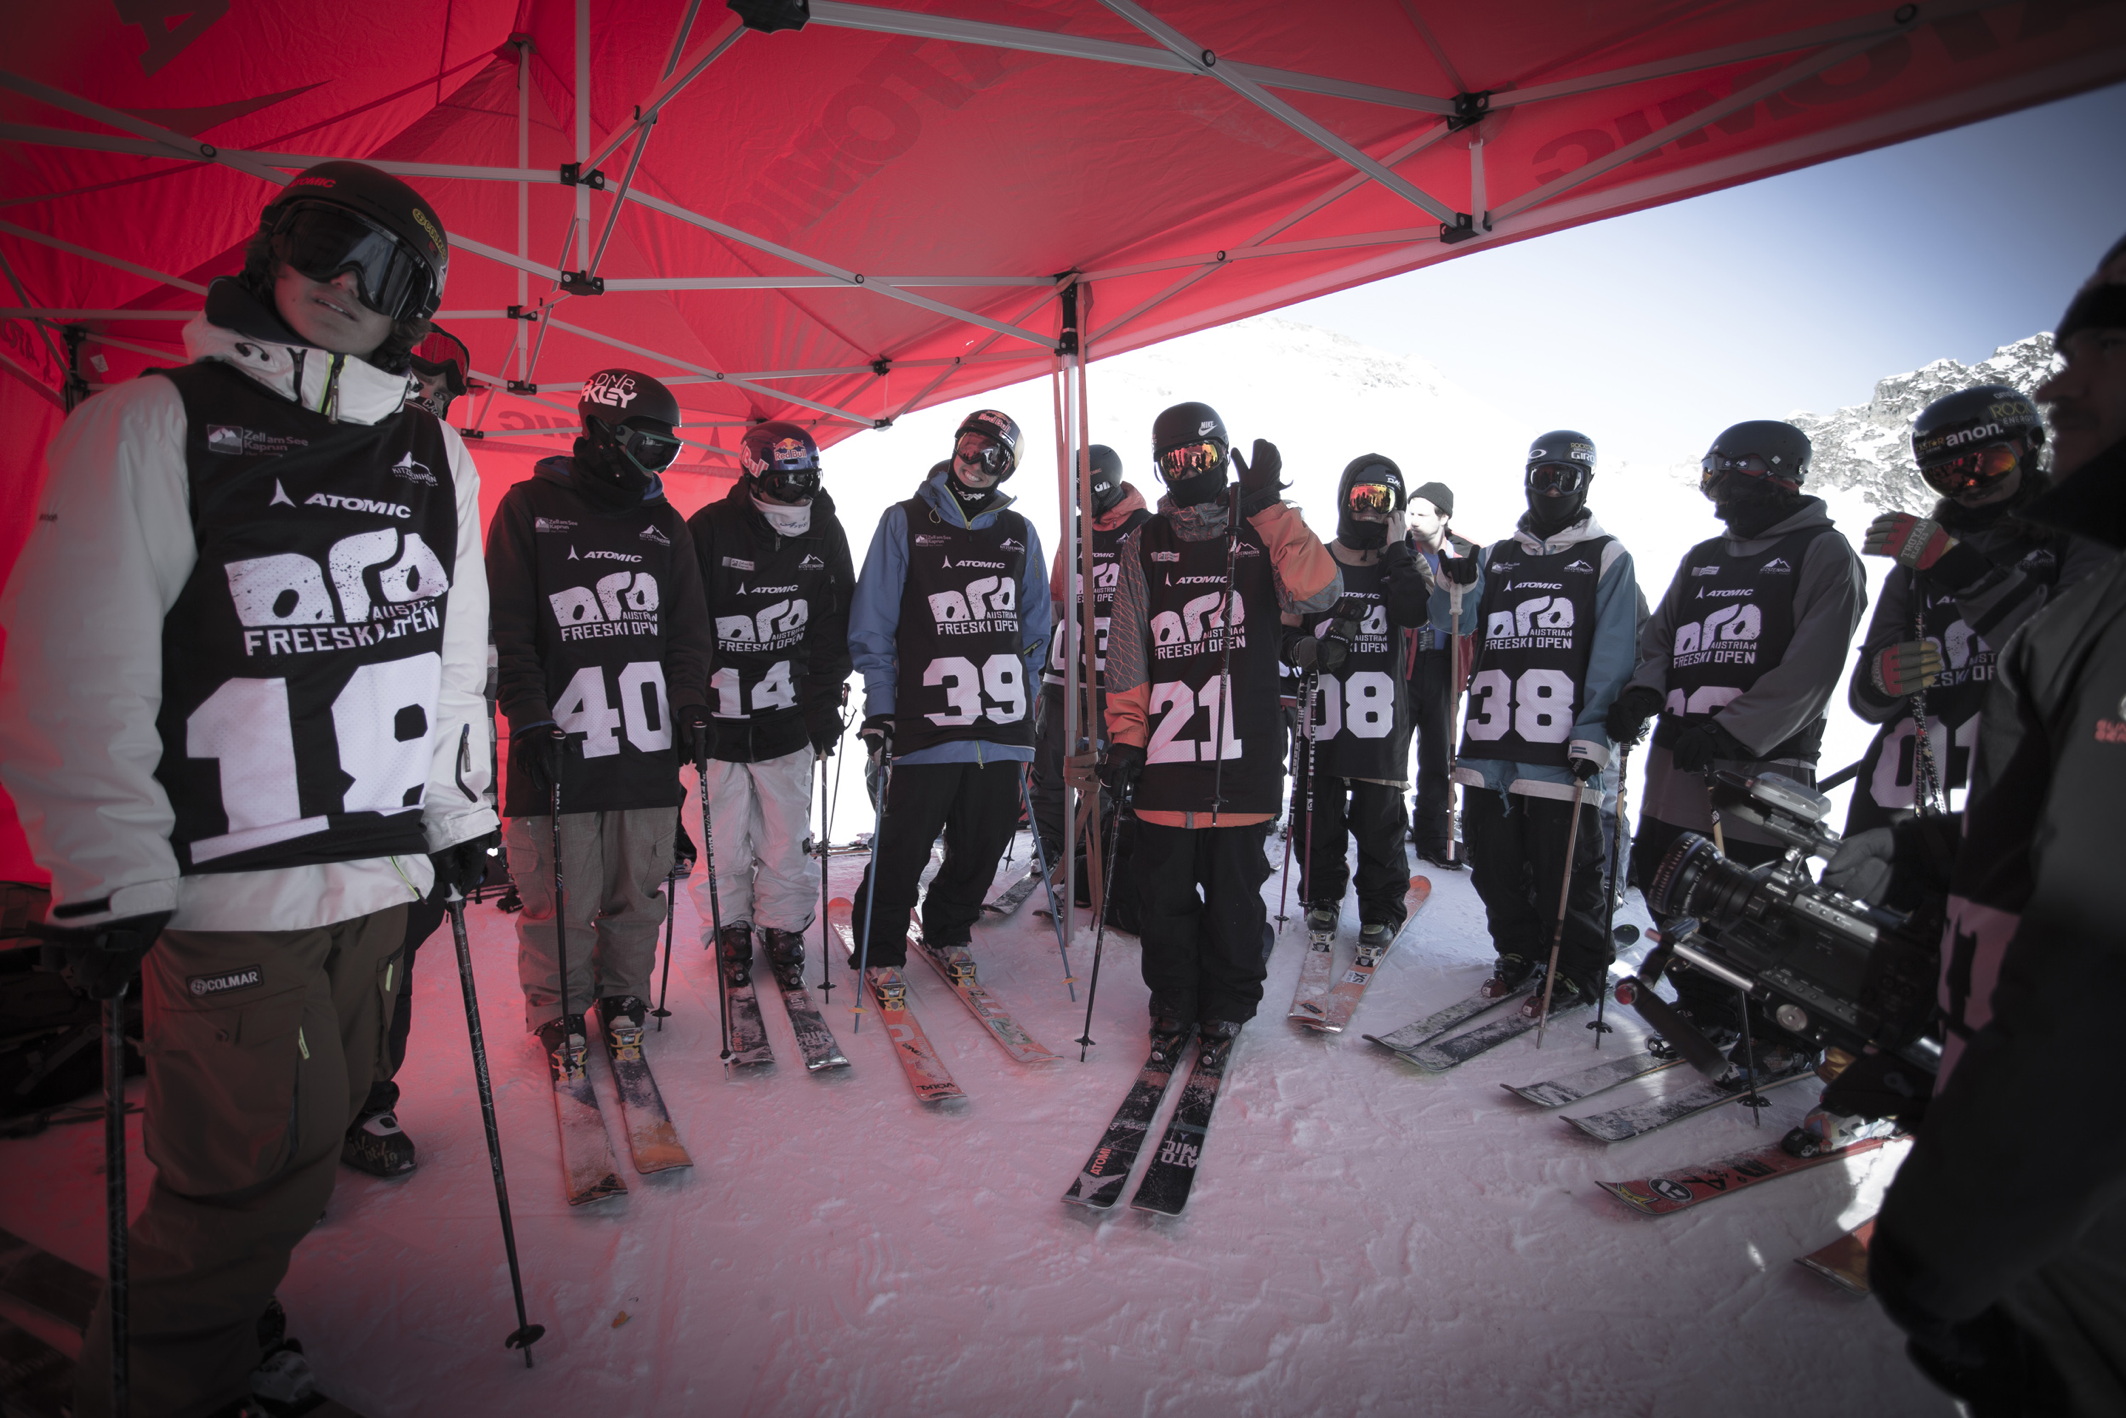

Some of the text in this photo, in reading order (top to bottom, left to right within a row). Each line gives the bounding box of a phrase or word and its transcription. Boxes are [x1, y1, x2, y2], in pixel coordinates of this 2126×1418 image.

[1201, 420, 1214, 429] NIKE
[244, 429, 309, 447] Zell am See
[1945, 423, 2004, 447] anon.
[244, 440, 288, 453] Kaprun
[774, 448, 808, 461] Red Bull
[1571, 452, 1595, 462] GIRO
[304, 493, 412, 519] ATOMIC
[1900, 519, 1929, 557] TROYAN
[583, 549, 643, 563] ATOMIC
[955, 560, 1006, 569] ATOMIC
[1176, 575, 1227, 584] ATOMIC
[1514, 581, 1563, 590] ATOMIC
[751, 584, 799, 594] ATOMIC
[1706, 588, 1754, 597] ATOMIC
[1097, 593, 1114, 602] OPE
[622, 611, 658, 622] AUSTRN
[986, 611, 1018, 620] AUSTRIAN
[561, 621, 658, 642] FREESKI OPN
[771, 626, 806, 641] AUSTRIAN
[937, 619, 1019, 635] FREESKI OPEN
[1203, 626, 1245, 639] AUSTIAN
[1529, 628, 1573, 637] AUSTRIAN
[718, 633, 804, 652] FREESKI OPEN
[1354, 634, 1388, 642] AUSTRAN
[1484, 636, 1572, 651] FREESKI OPEN
[1361, 642, 1388, 653] OPEN
[1710, 641, 1757, 651] AUSTRIAN
[1673, 650, 1756, 669] FREESKI OPEN
[710, 660, 798, 719] 14
[923, 653, 1027, 727] 39
[551, 661, 672, 759] 40
[1303, 671, 1395, 742] 08
[1466, 669, 1574, 744] 38
[1145, 674, 1243, 766] 21
[186, 651, 442, 865] 18
[206, 970, 259, 993] COLMAR
[1162, 1140, 1199, 1157] MIC
[1161, 1153, 1199, 1169] ATO
